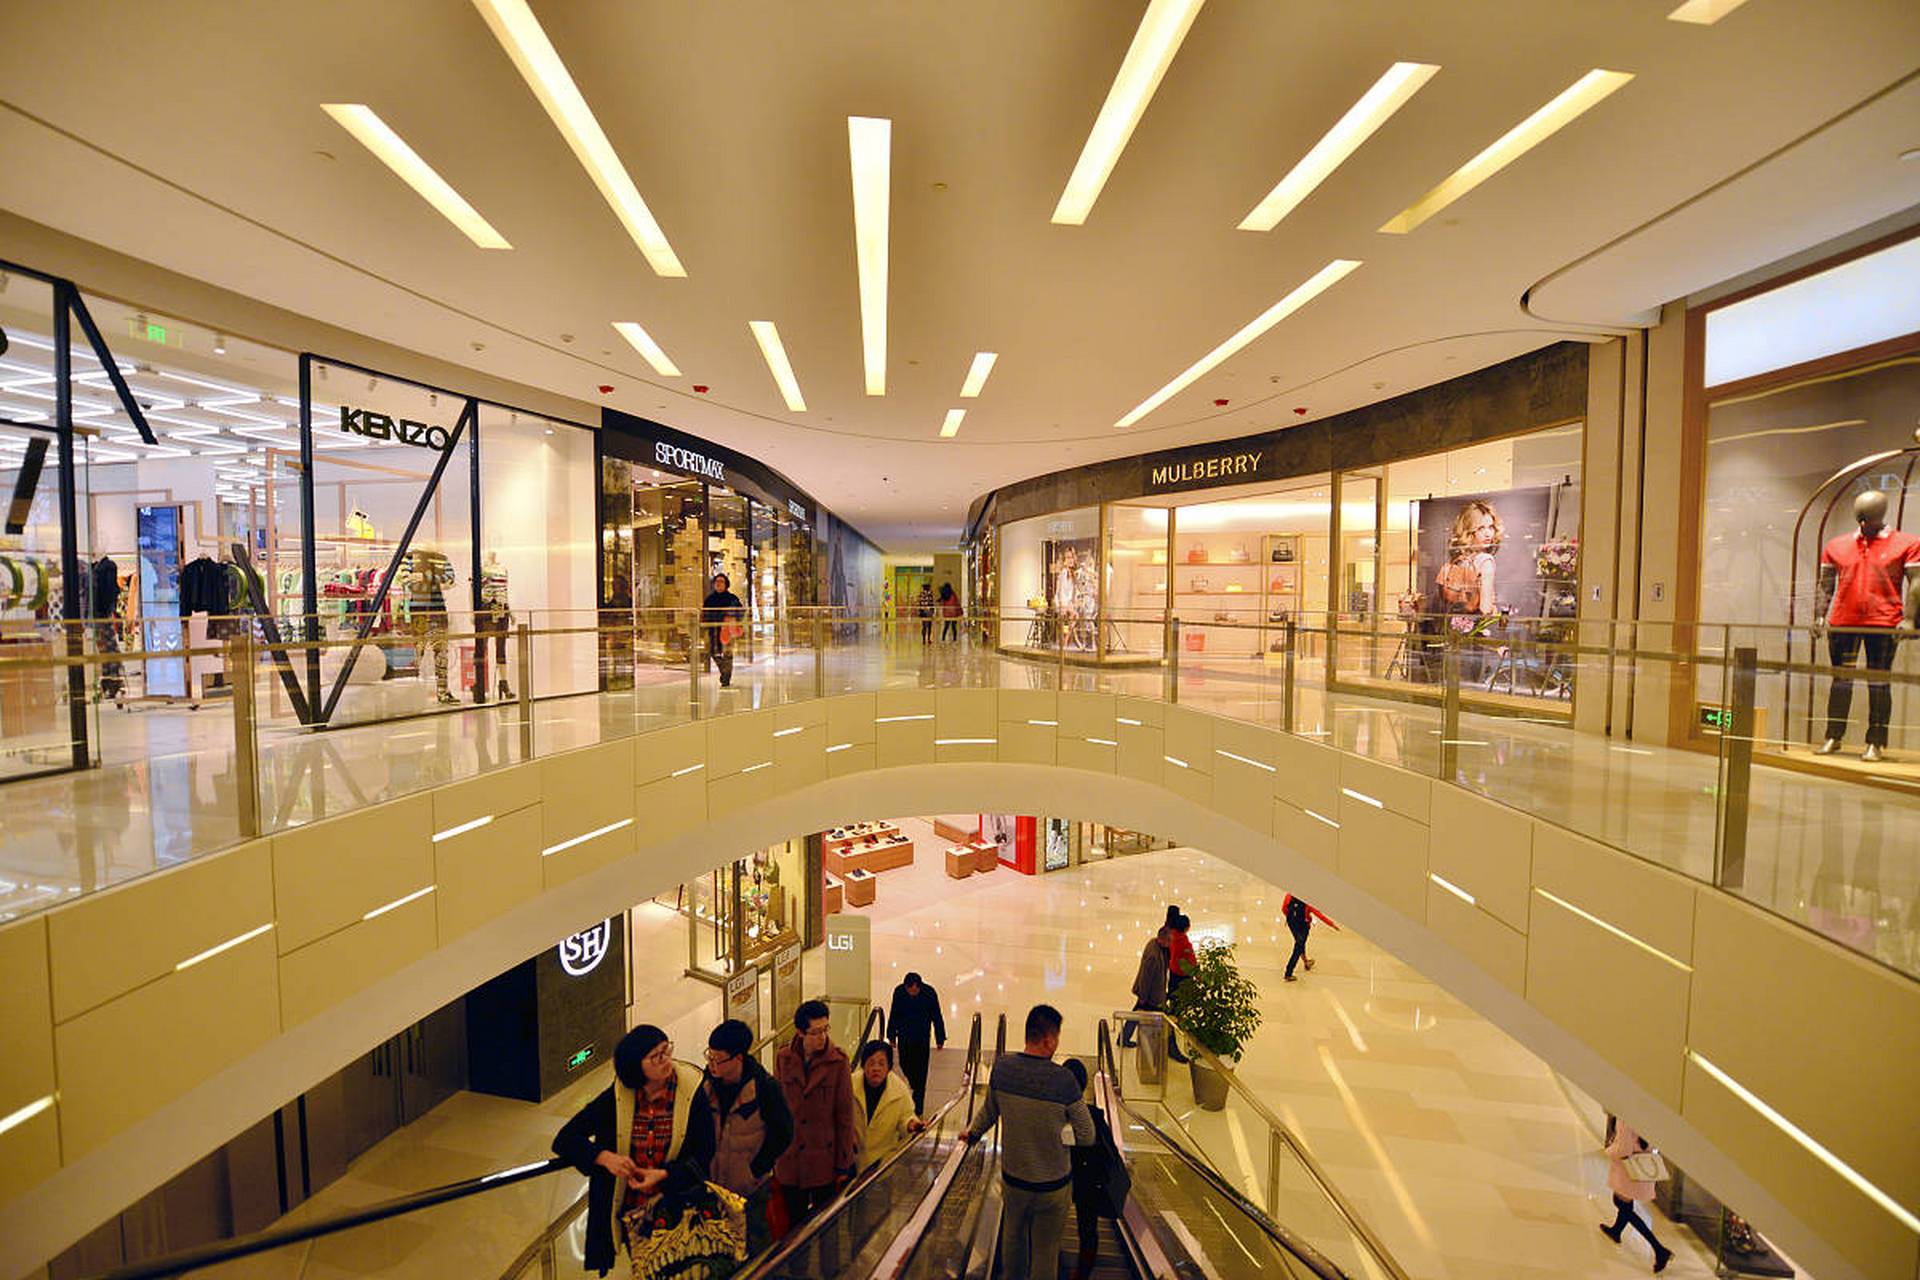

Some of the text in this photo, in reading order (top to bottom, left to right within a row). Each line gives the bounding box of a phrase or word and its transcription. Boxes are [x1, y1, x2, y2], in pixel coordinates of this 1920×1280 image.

[341, 406, 450, 451] KENZO
[655, 441, 726, 481] SPORTMAX
[1152, 452, 1263, 485] MULBERRY
[564, 926, 603, 962] SH
